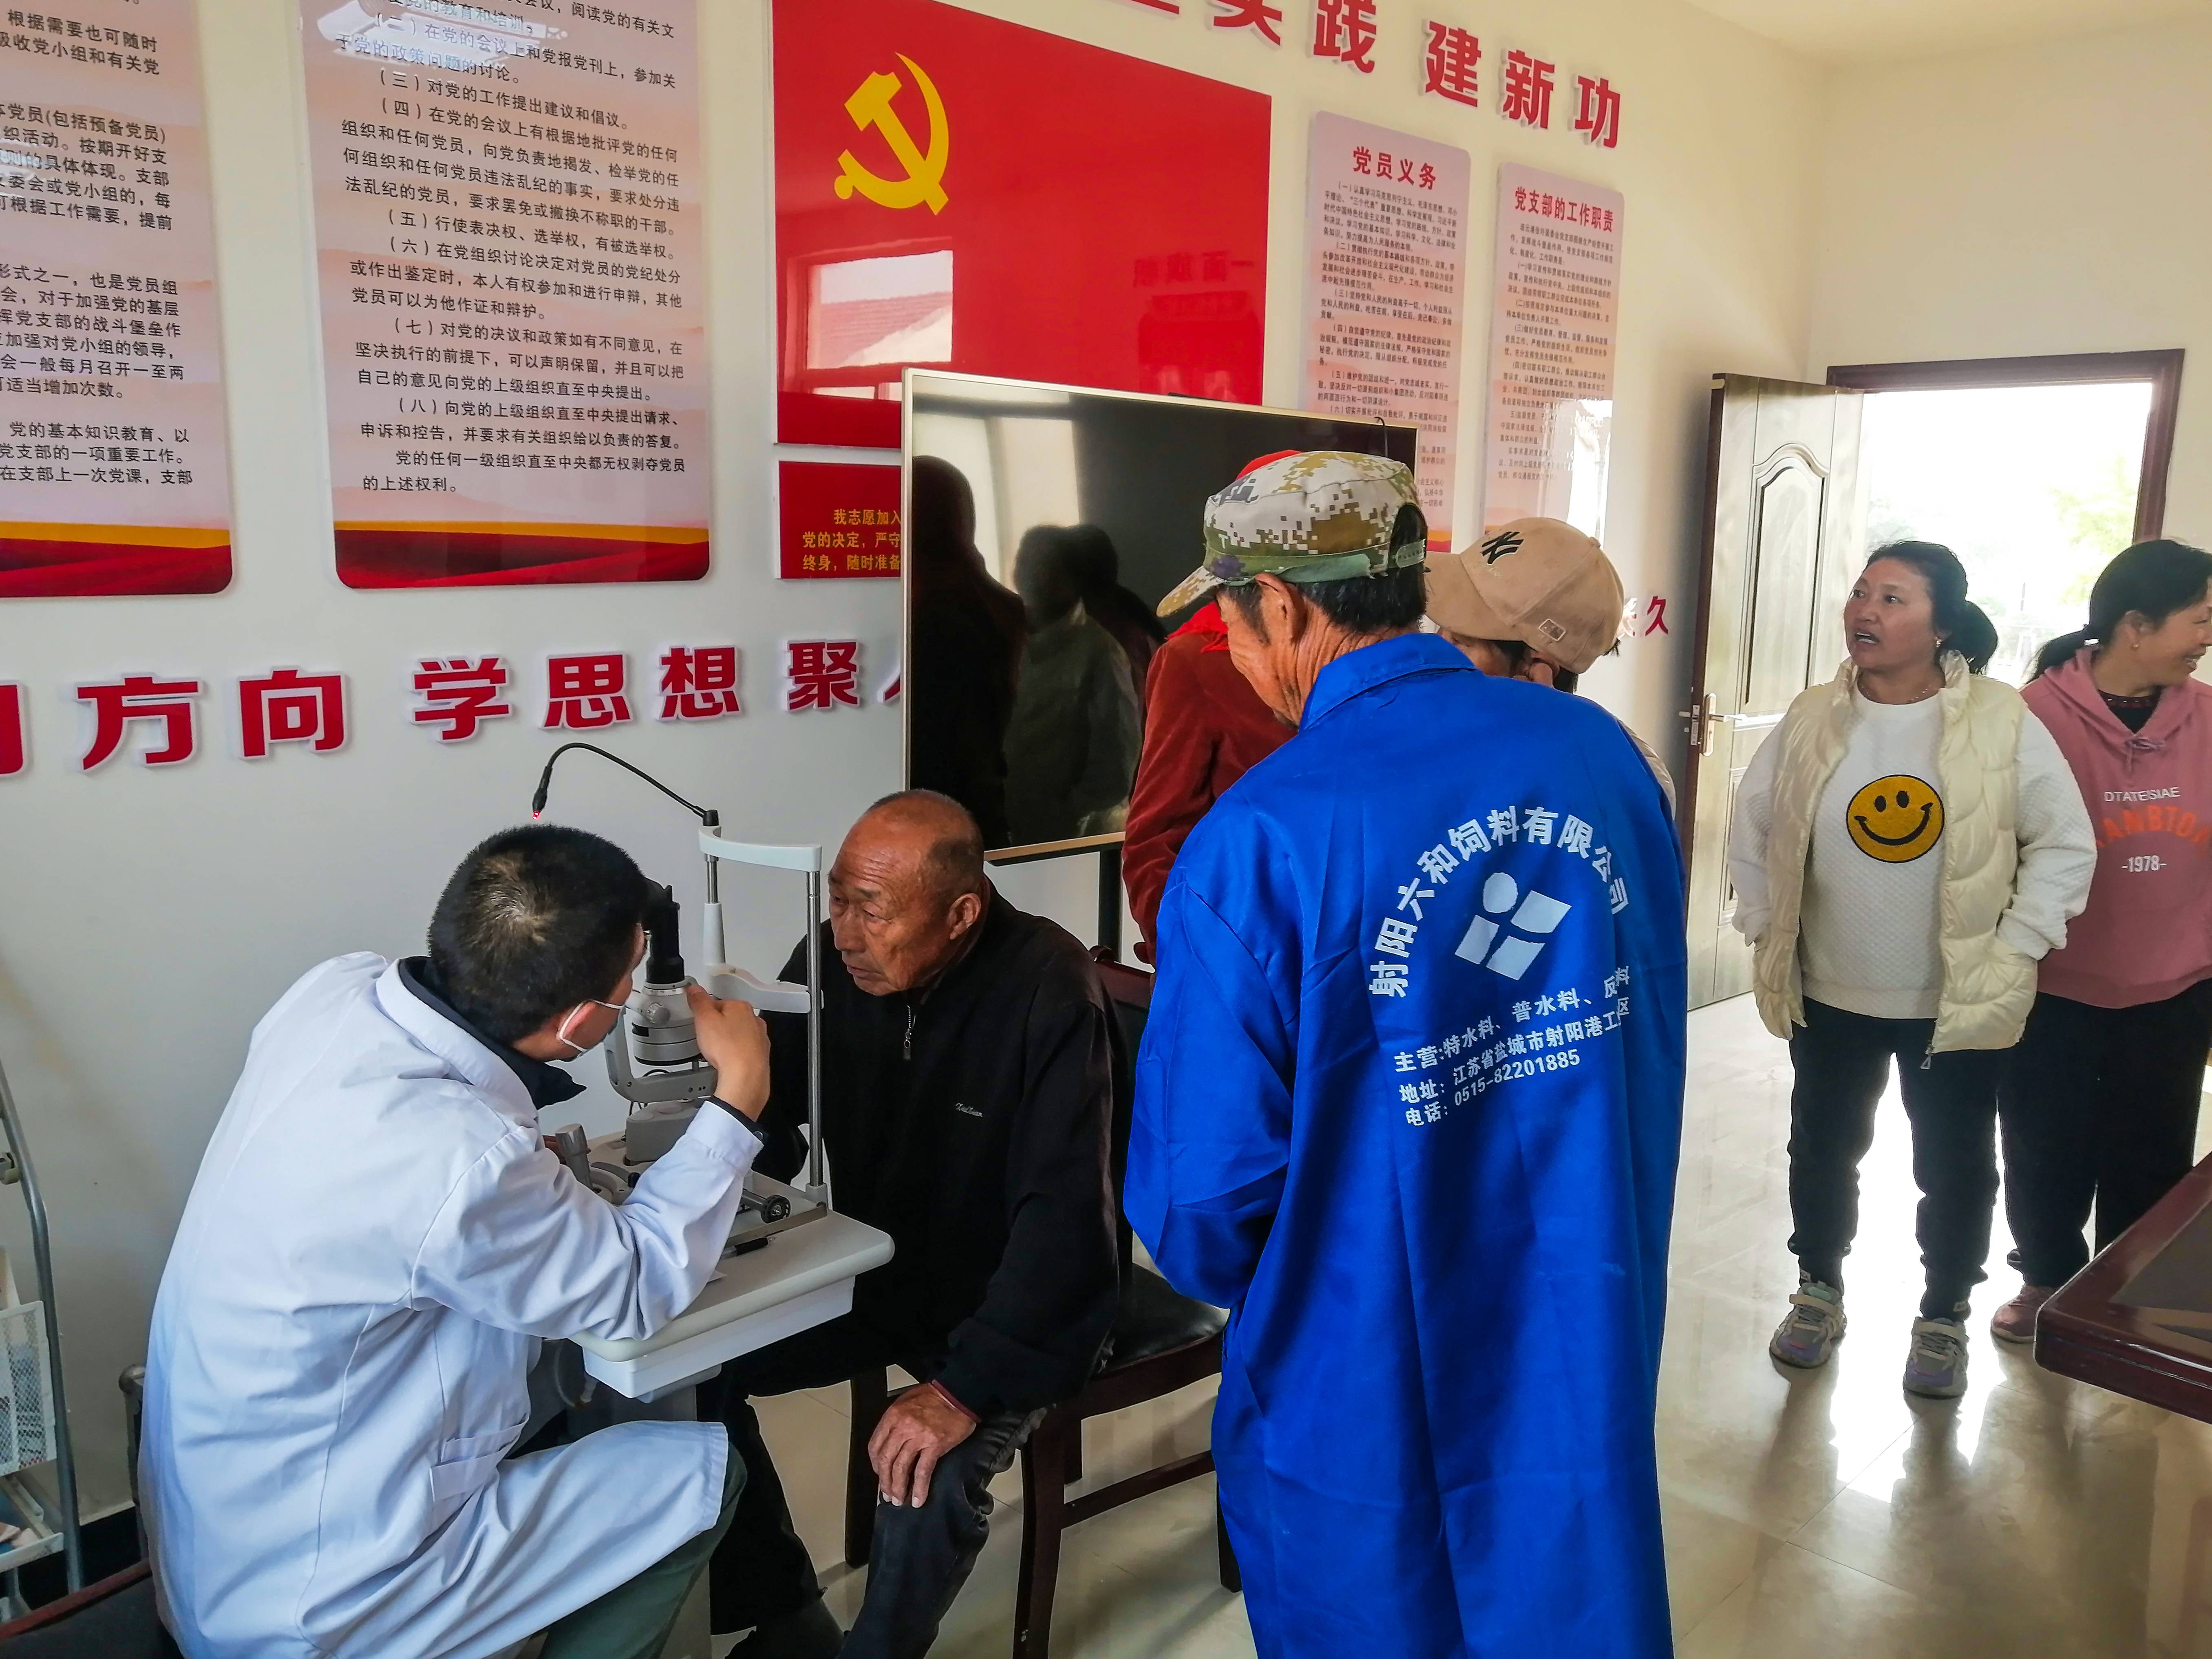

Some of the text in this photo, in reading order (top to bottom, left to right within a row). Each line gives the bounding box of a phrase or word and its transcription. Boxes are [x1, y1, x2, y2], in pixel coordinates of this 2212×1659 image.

[8, 9, 157, 52] 根据需要也可随时
[381, 68, 627, 130] （三）对党的工作提出建议和倡议。
[1425, 20, 1620, 148] 建新功
[382, 97, 678, 163] （四）在党的会议上有根据地批评党的任何
[342, 119, 680, 187] 组织和任何党员，向党负责地揭发、检举党的任
[1353, 146, 1436, 190] 党员义务
[343, 147, 680, 212] 何组织和任何党员违法乱纪的事实，要求处分违
[1515, 186, 1614, 232] 党支部的工作职责
[389, 209, 674, 260] （五）行使表决权、选举权，有被选举权。
[391, 236, 681, 284] （六）在党组织讨论决定对党员的党纪处分
[1, 286, 179, 316] 会，对于加强党的基层
[0, 332, 173, 359] 加强对党小组的领导，
[395, 317, 682, 355] （七）对党的决议和政策如有不同意见，在
[0, 353, 183, 380] 会一般每月召开一至两
[355, 342, 684, 379] 坚决执行的前提下，可以声明保留，并且可以把
[0, 377, 122, 399] 适当增加次数。
[358, 368, 650, 401] 自己的意见向党的上级组织直至中央提出。
[399, 397, 678, 426] （八）向党的上级组织直至中央提出请求、
[10, 421, 190, 442] 党的基本知识教育、以
[361, 422, 679, 449] 申诉和控告，并要求有关组织给以负责的答复。
[0, 443, 183, 464] 党支部的一项重要工作。
[396, 450, 685, 472] 党的任何一级组织直至中央都无权剥夺党员
[0, 465, 192, 484] 在支部上一次党课，支部
[363, 475, 457, 492] 的上述权利。
[834, 508, 901, 525] 我志愿加入
[803, 531, 900, 548] 党的决定，严守
[803, 554, 900, 571] 终身，随时准备
[413, 646, 740, 741] 学思想
[788, 641, 901, 712] 聚
[1369, 805, 1629, 997] 射阳六和饲料有限公司
